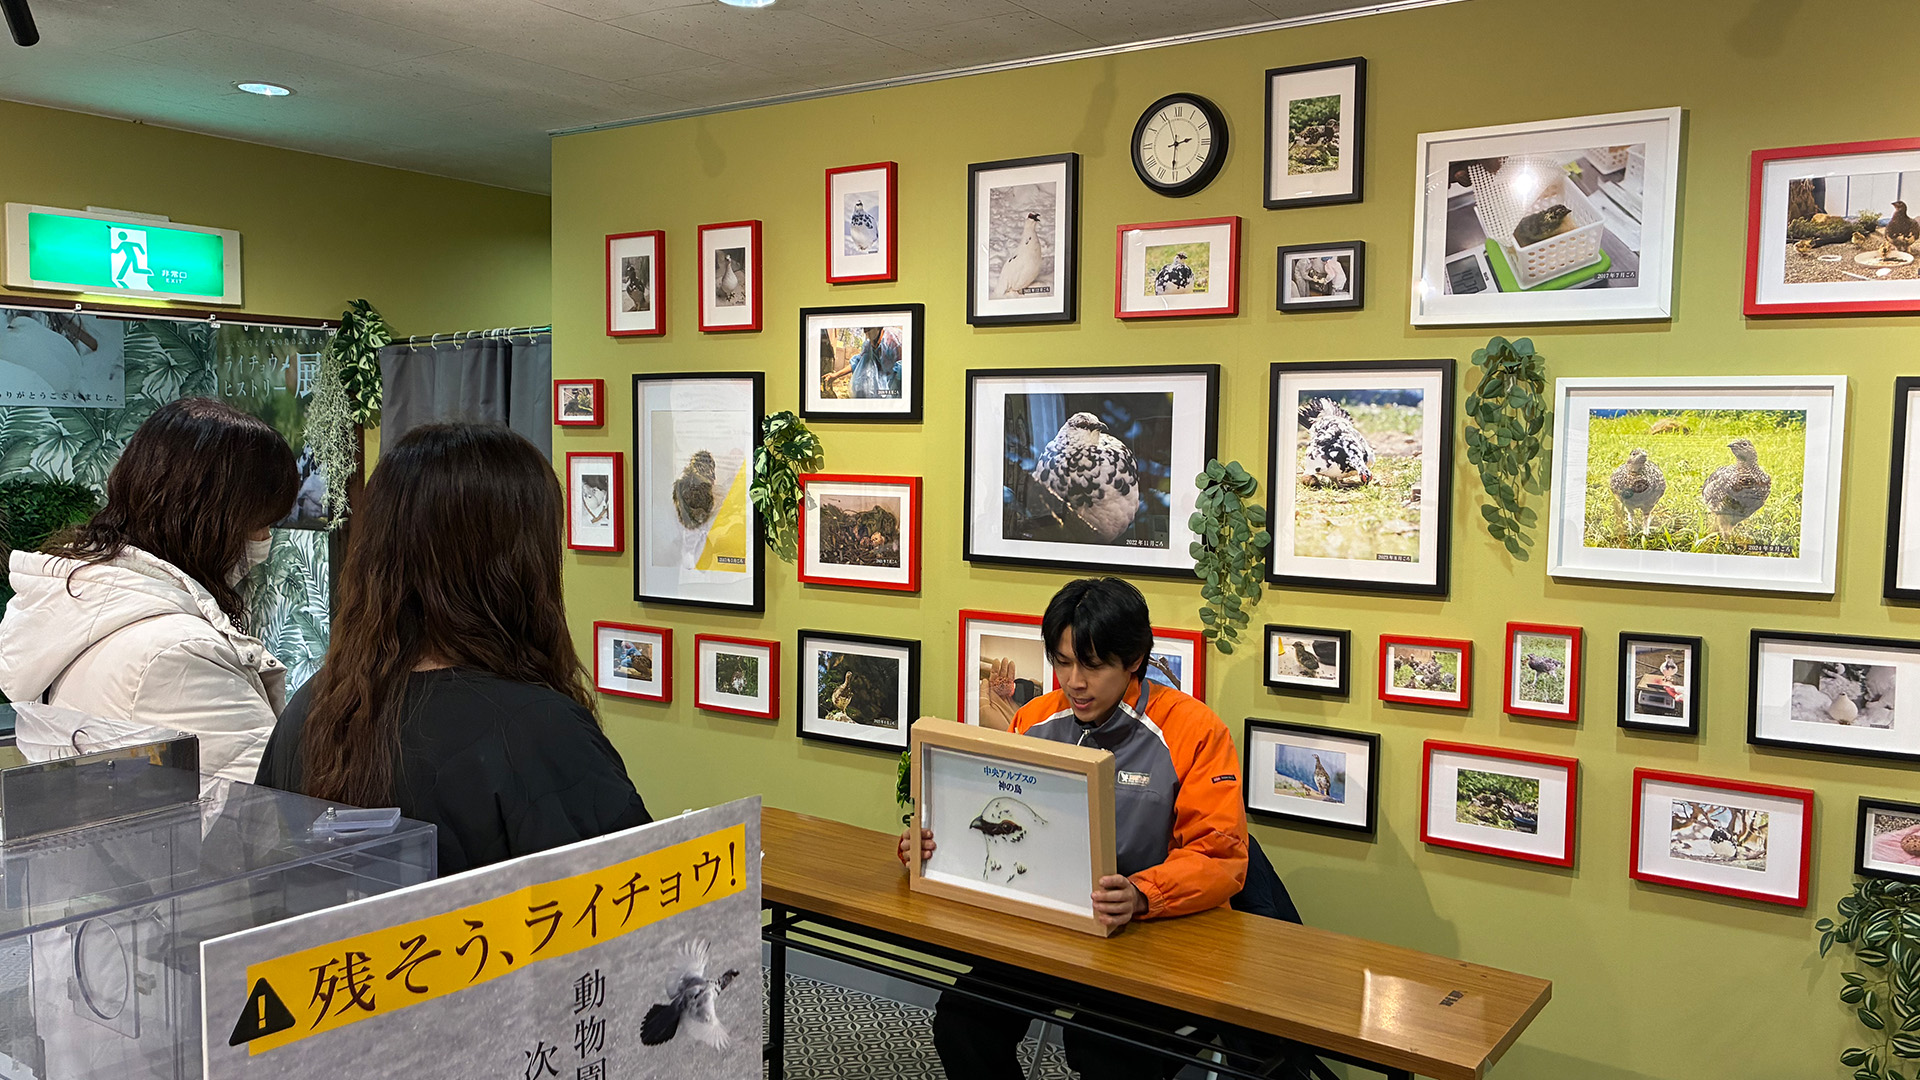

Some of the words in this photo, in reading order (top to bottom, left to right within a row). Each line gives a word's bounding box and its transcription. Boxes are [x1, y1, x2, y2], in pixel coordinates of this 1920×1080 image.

[162, 269, 187, 279] 非常口
[224, 353, 278, 374] ライチョウ
[295, 351, 322, 399] 展
[0, 391, 118, 402] りがとうございました。
[224, 379, 287, 398] ヒストリー
[983, 765, 1037, 785] 中央アルプスの
[525, 1041, 559, 1080] 次
